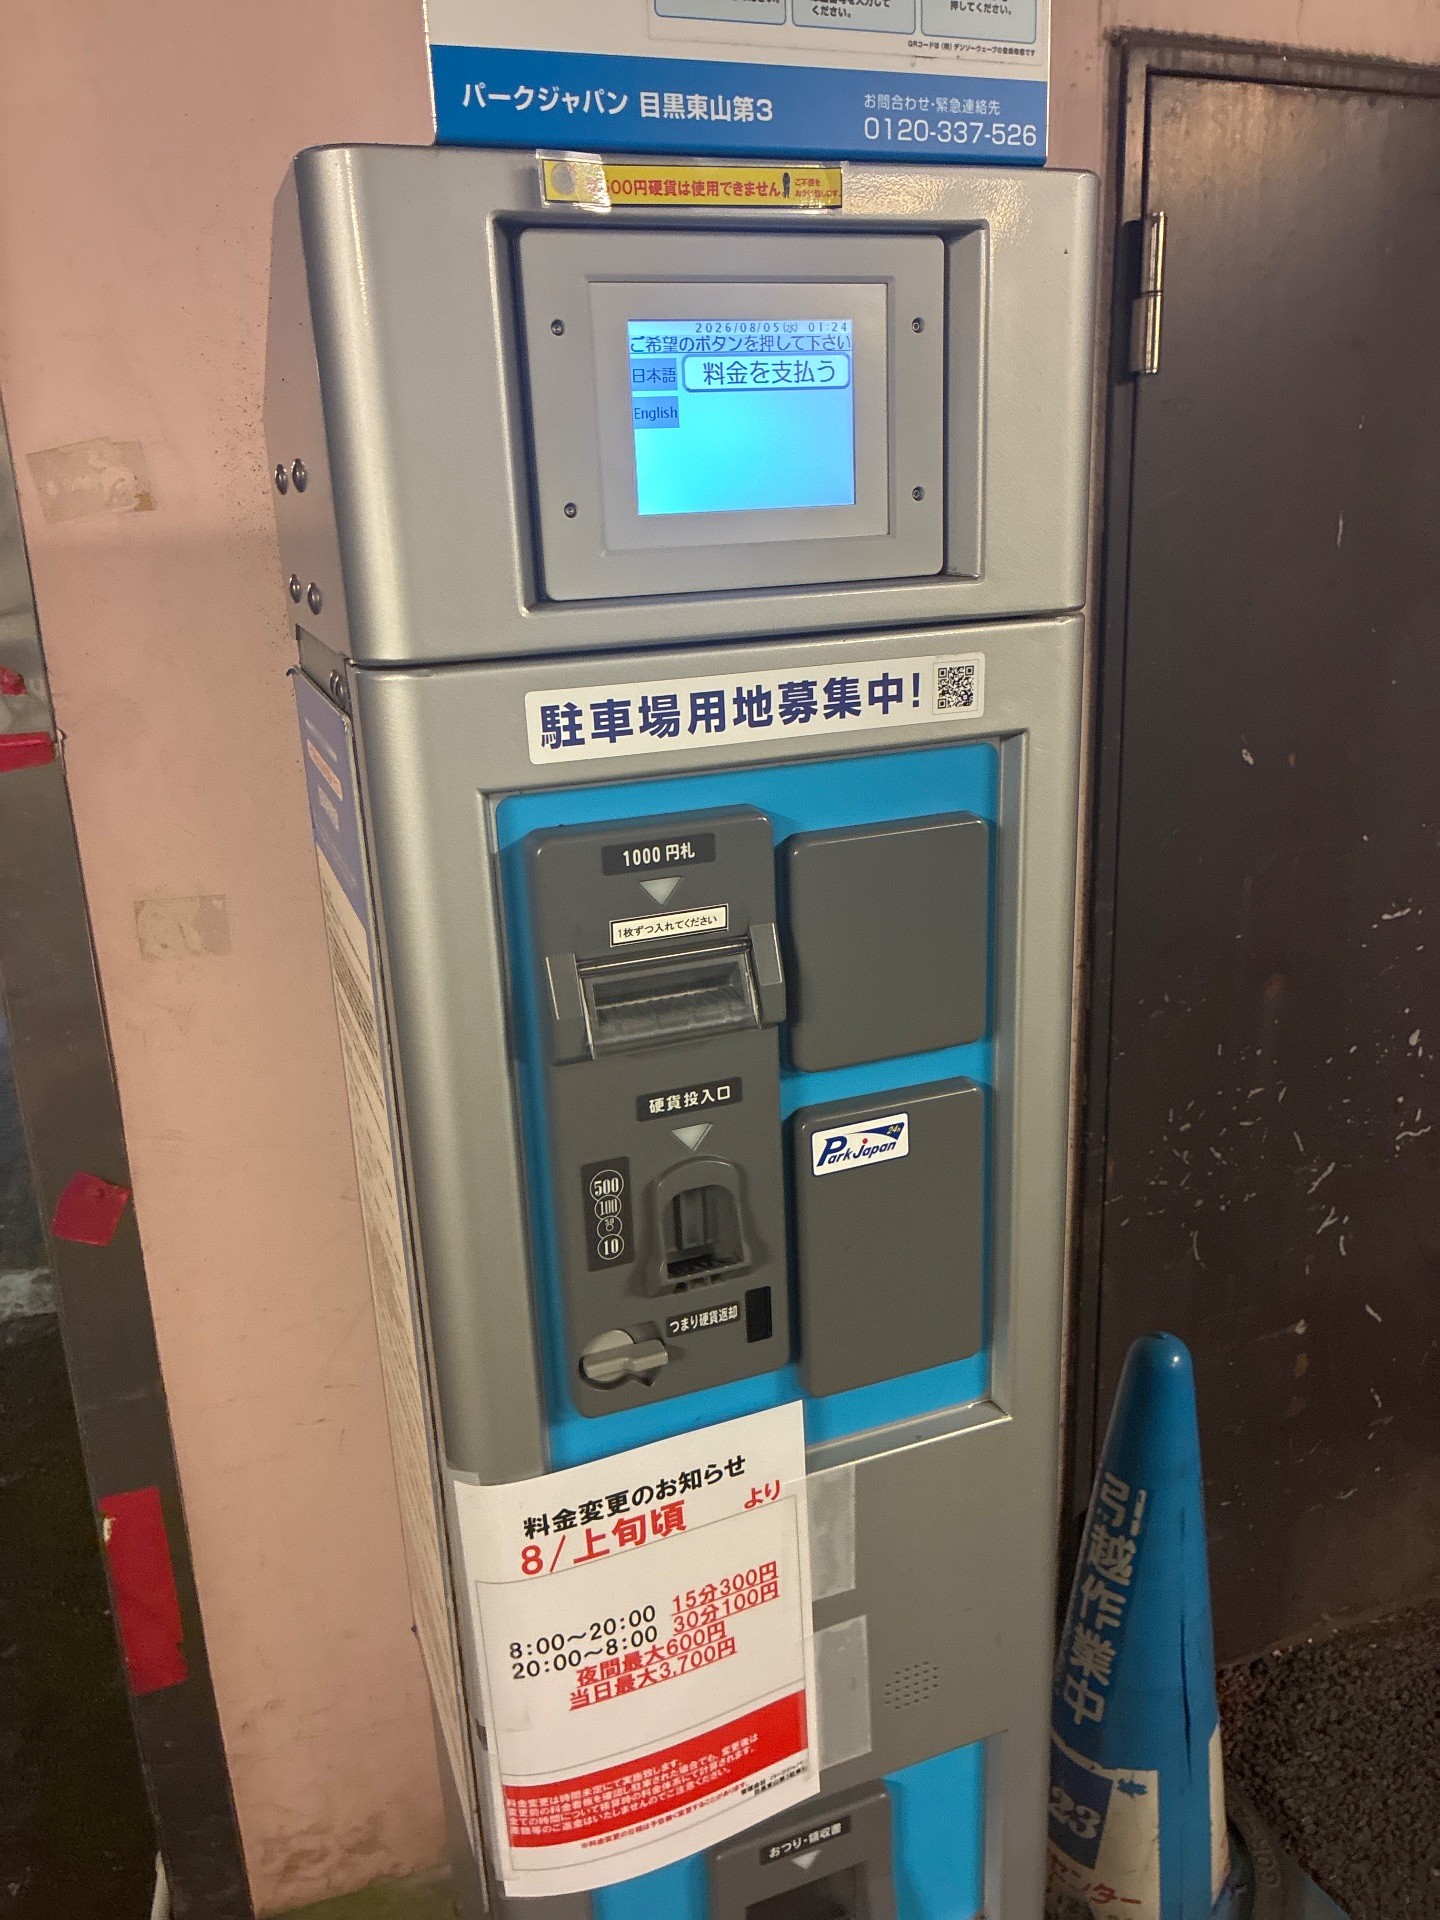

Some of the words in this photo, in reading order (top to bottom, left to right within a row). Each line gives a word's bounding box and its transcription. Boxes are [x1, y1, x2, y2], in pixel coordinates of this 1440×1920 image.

[811, 5, 852, 18] ください。
[463, 81, 628, 115] パークジャパン
[640, 91, 773, 122] 目黒東山第3
[863, 93, 1001, 115] お問合わせ・緊急連絡先
[864, 117, 1037, 146] 0120-337-526
[808, 321, 848, 332] 01:24
[631, 335, 851, 353] ご希望のボタンを押して下さい
[632, 367, 677, 384] 日本語
[703, 360, 836, 386] 料金を支払う
[634, 406, 678, 421] English
[540, 672, 921, 750] 駐車場用地募集中!
[618, 915, 717, 939] 1枚ずつ入れてください
[648, 1085, 731, 1114] 硬貨投入口
[593, 1177, 619, 1197] 500
[599, 1198, 618, 1216] 100
[604, 1238, 619, 1256] 10
[669, 1305, 738, 1334] つまり硬貨返却
[523, 1455, 746, 1540] 料金変更のお知らせ
[743, 1479, 782, 1511] より
[672, 1561, 778, 1615] 15分300円
[673, 1580, 780, 1635] 30分100円
[576, 1620, 727, 1687] 夜間最大600円
[569, 1636, 737, 1711] 当日最大3,700円
